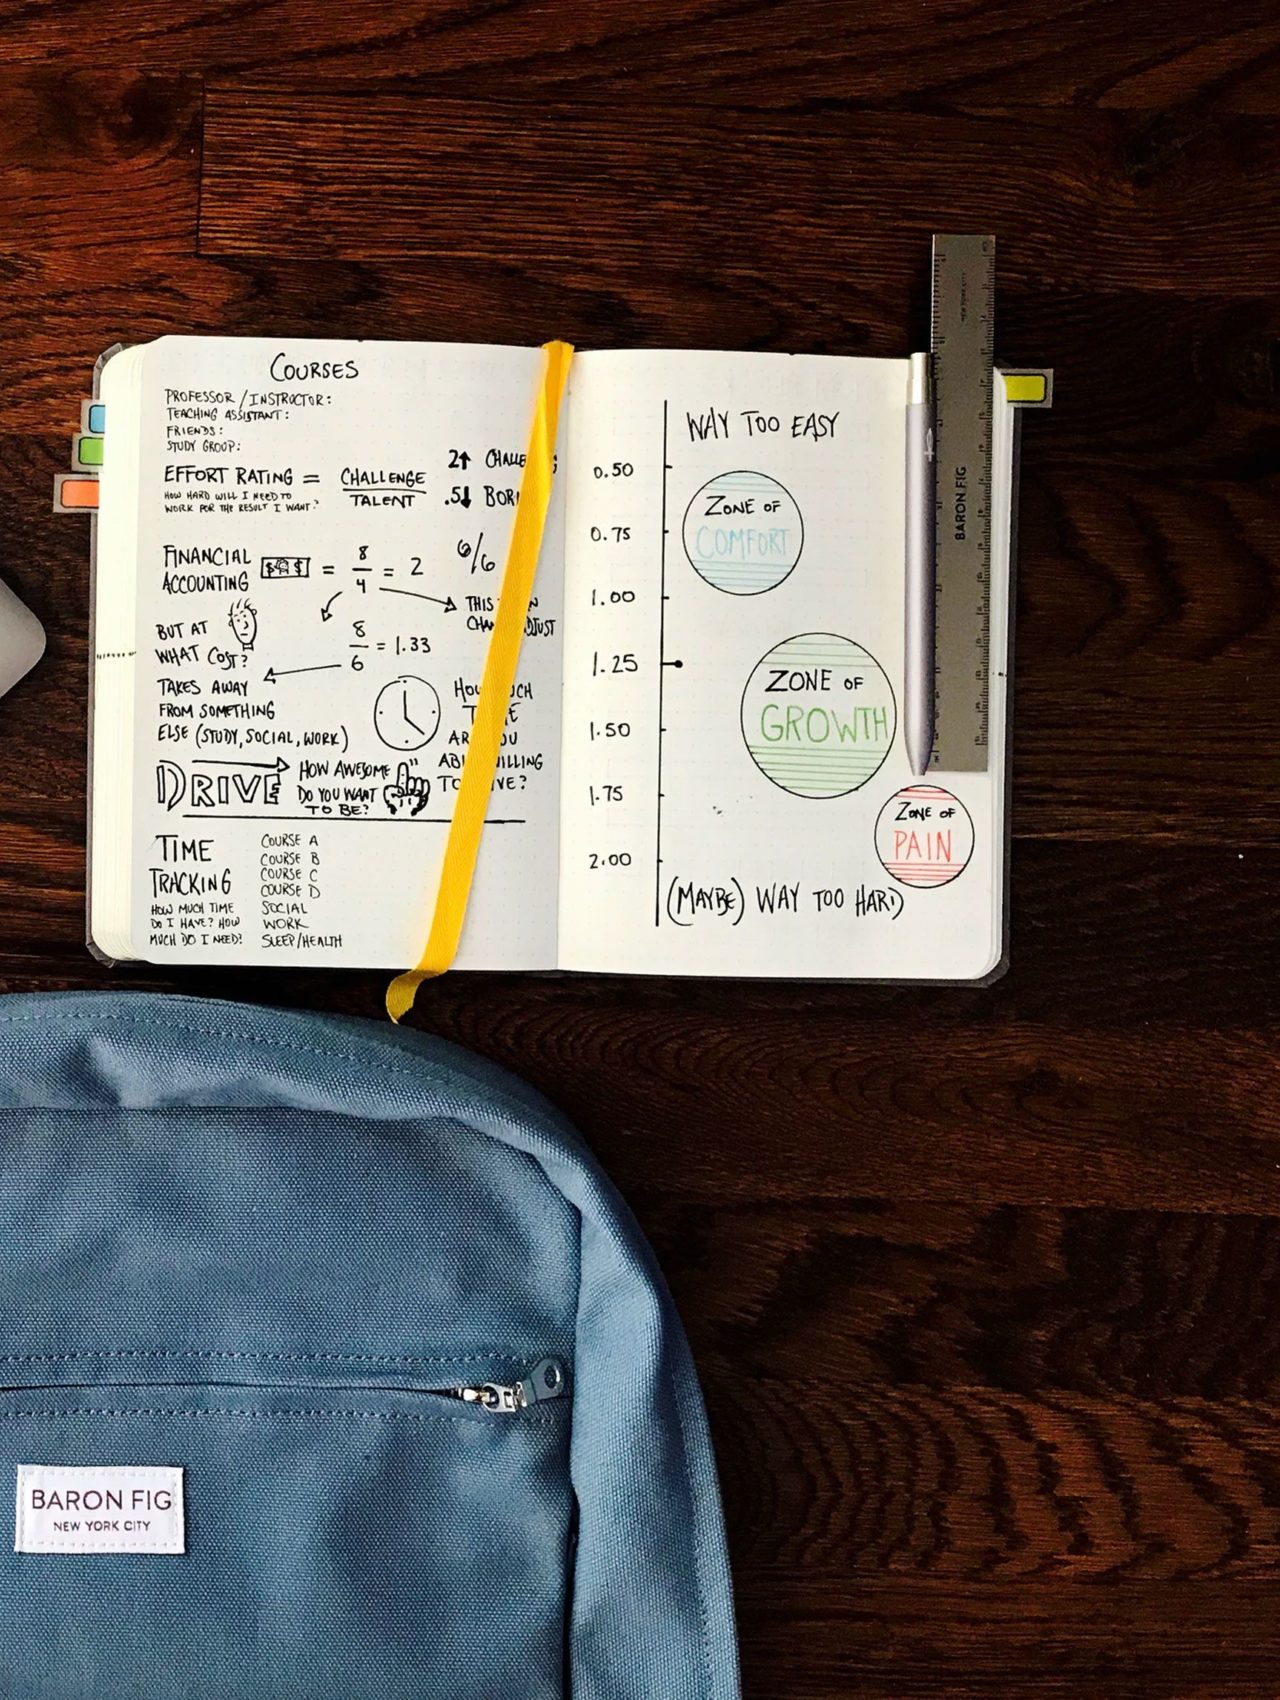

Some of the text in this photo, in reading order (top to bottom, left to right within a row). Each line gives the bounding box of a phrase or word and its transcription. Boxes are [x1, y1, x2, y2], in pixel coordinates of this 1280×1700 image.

[270, 352, 359, 381] COURSES
[167, 407, 290, 422] TEACHING ASSISTANT:
[686, 406, 840, 442] WAY TOO EASY
[167, 426, 223, 437] FRIENDS:
[167, 439, 241, 453] STUDY GROUP:
[164, 465, 293, 485] EFFORT RATING
[593, 463, 634, 479] 0.50
[164, 491, 182, 500] HOW
[187, 490, 210, 500] HARD
[215, 491, 237, 500] WILL
[242, 491, 248, 500] I
[280, 492, 292, 500] TO
[955, 467, 967, 541] BARON FIG
[165, 504, 193, 513] WORK
[199, 504, 215, 513] FOR
[238, 503, 268, 512] RESULT
[274, 504, 280, 512] I
[704, 495, 782, 516] ZONE OF
[590, 526, 631, 543] 0.75
[695, 525, 790, 560] COMFORT
[163, 545, 252, 568] FINANCIAL
[358, 545, 370, 561] 8
[162, 571, 250, 595] ACCOUNTING
[465, 595, 494, 612] THIS
[592, 589, 636, 606] 1.00
[156, 621, 208, 641] BUT AT
[352, 620, 366, 638] 8
[396, 635, 431, 655] 1.33
[155, 644, 248, 671] WHAT COST?
[351, 655, 364, 671] 6
[592, 651, 639, 677] 1.25
[157, 678, 248, 696] TAKES AWAY
[764, 669, 864, 692] ZONE OF
[159, 700, 275, 720] FROM SOMETHING
[589, 721, 632, 741] 1.50
[760, 703, 889, 743] GROWTH
[158, 724, 189, 742] ELSE
[245, 728, 300, 747] SOCIAL,
[303, 725, 349, 753] WORK)
[448, 730, 518, 746] AR OU
[299, 759, 390, 781] HOW AWESOME
[156, 759, 281, 812] DRIVE
[297, 785, 378, 804] DO YOU WANT
[589, 785, 624, 806] 1.75
[305, 803, 369, 816] TO BE?
[939, 808, 956, 819] OF
[155, 833, 319, 862] TIME COURSE A
[894, 829, 951, 862] PAIN
[260, 851, 320, 866] COURSE B
[588, 852, 632, 870] 2.00
[149, 867, 318, 898] TRACKING COURSE C
[260, 883, 321, 899] COURSE D
[151, 901, 234, 915] HOW MUCH TIME
[261, 901, 308, 915] SOCIAL
[667, 876, 744, 926] (MAYBE)
[756, 881, 800, 914] WAY
[812, 888, 844, 912] TOO
[151, 918, 162, 929] DO
[166, 917, 175, 928] I
[218, 916, 240, 929] HOW
[263, 918, 310, 930] WORK
[150, 932, 176, 946] MUCH
[180, 932, 196, 946] DO
[201, 934, 209, 945] I
[32, 1489, 172, 1511] BARON FIG
[53, 1520, 151, 1532] NEW YORK CITY
